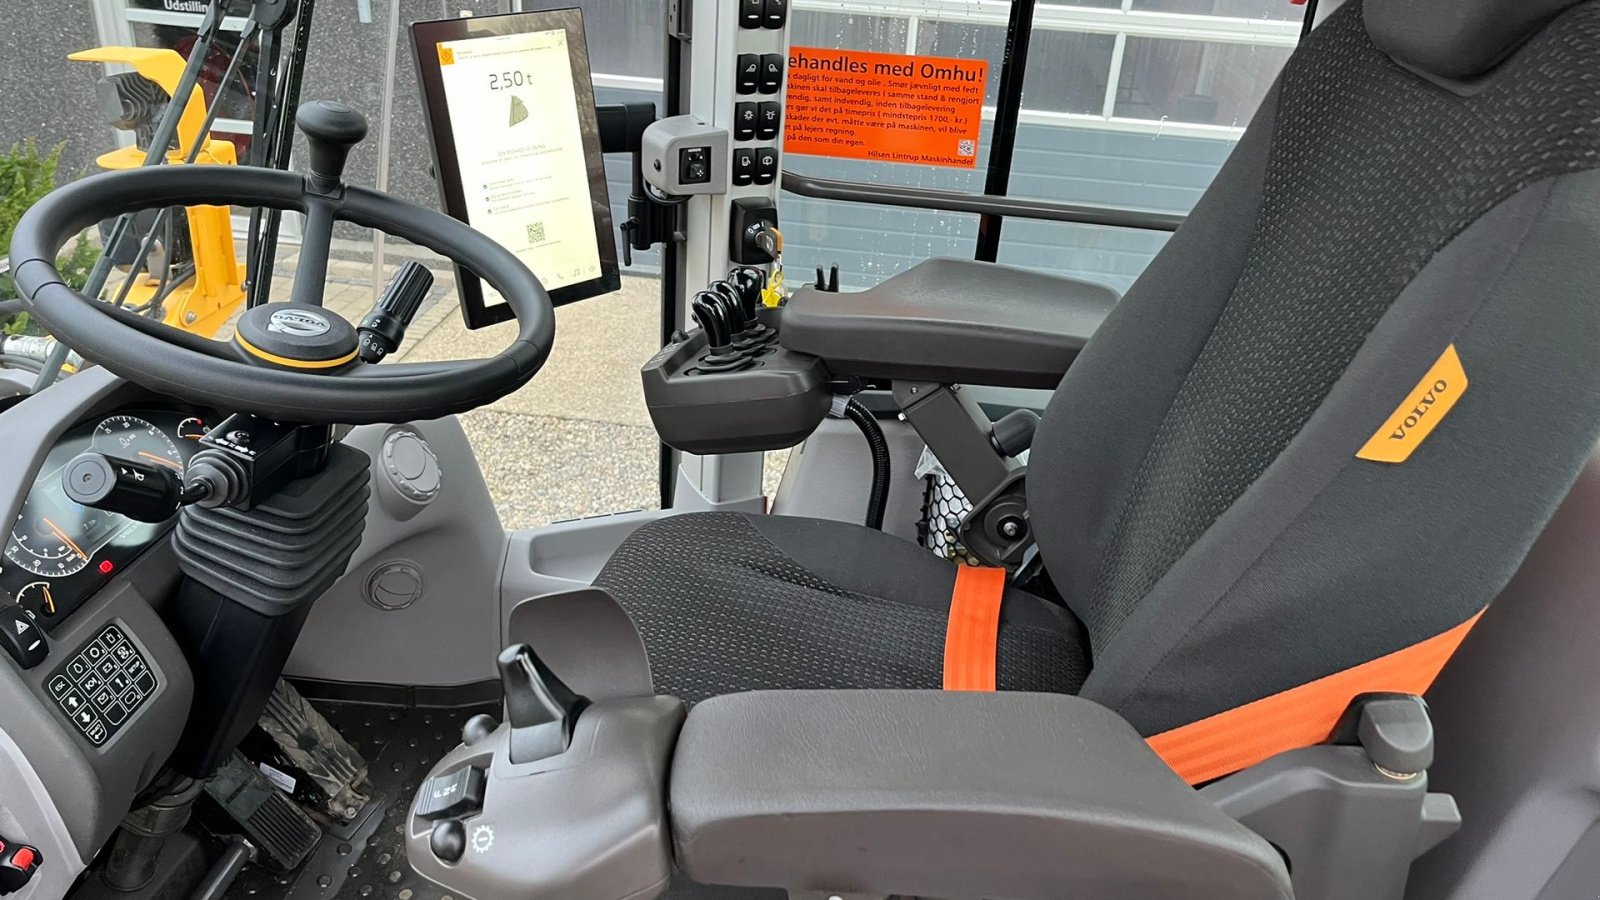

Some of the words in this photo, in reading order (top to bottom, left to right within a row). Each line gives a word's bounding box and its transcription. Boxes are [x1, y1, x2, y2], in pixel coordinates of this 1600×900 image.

[874, 62, 914, 77] med
[921, 64, 983, 82] Omhu!
[489, 70, 523, 90] 2,50
[527, 72, 532, 85] t
[793, 73, 819, 82] dagligt
[910, 82, 941, 91] jævnligt
[943, 84, 960, 92] med
[963, 85, 978, 94] fedt
[829, 86, 881, 96] tilbageleveres
[899, 102, 956, 113] tilbagelevering
[845, 109, 875, 117] timepris
[883, 111, 927, 121] mindstepris
[804, 125, 823, 133] lejers
[842, 118, 864, 126] måtte
[898, 122, 936, 132] maskinen,
[892, 152, 919, 162] Lintrup
[921, 155, 973, 165] Maskinhandel
[274, 315, 326, 327] VOLVO
[1388, 379, 1447, 440] VOLVO
[55, 681, 66, 692] ESC
